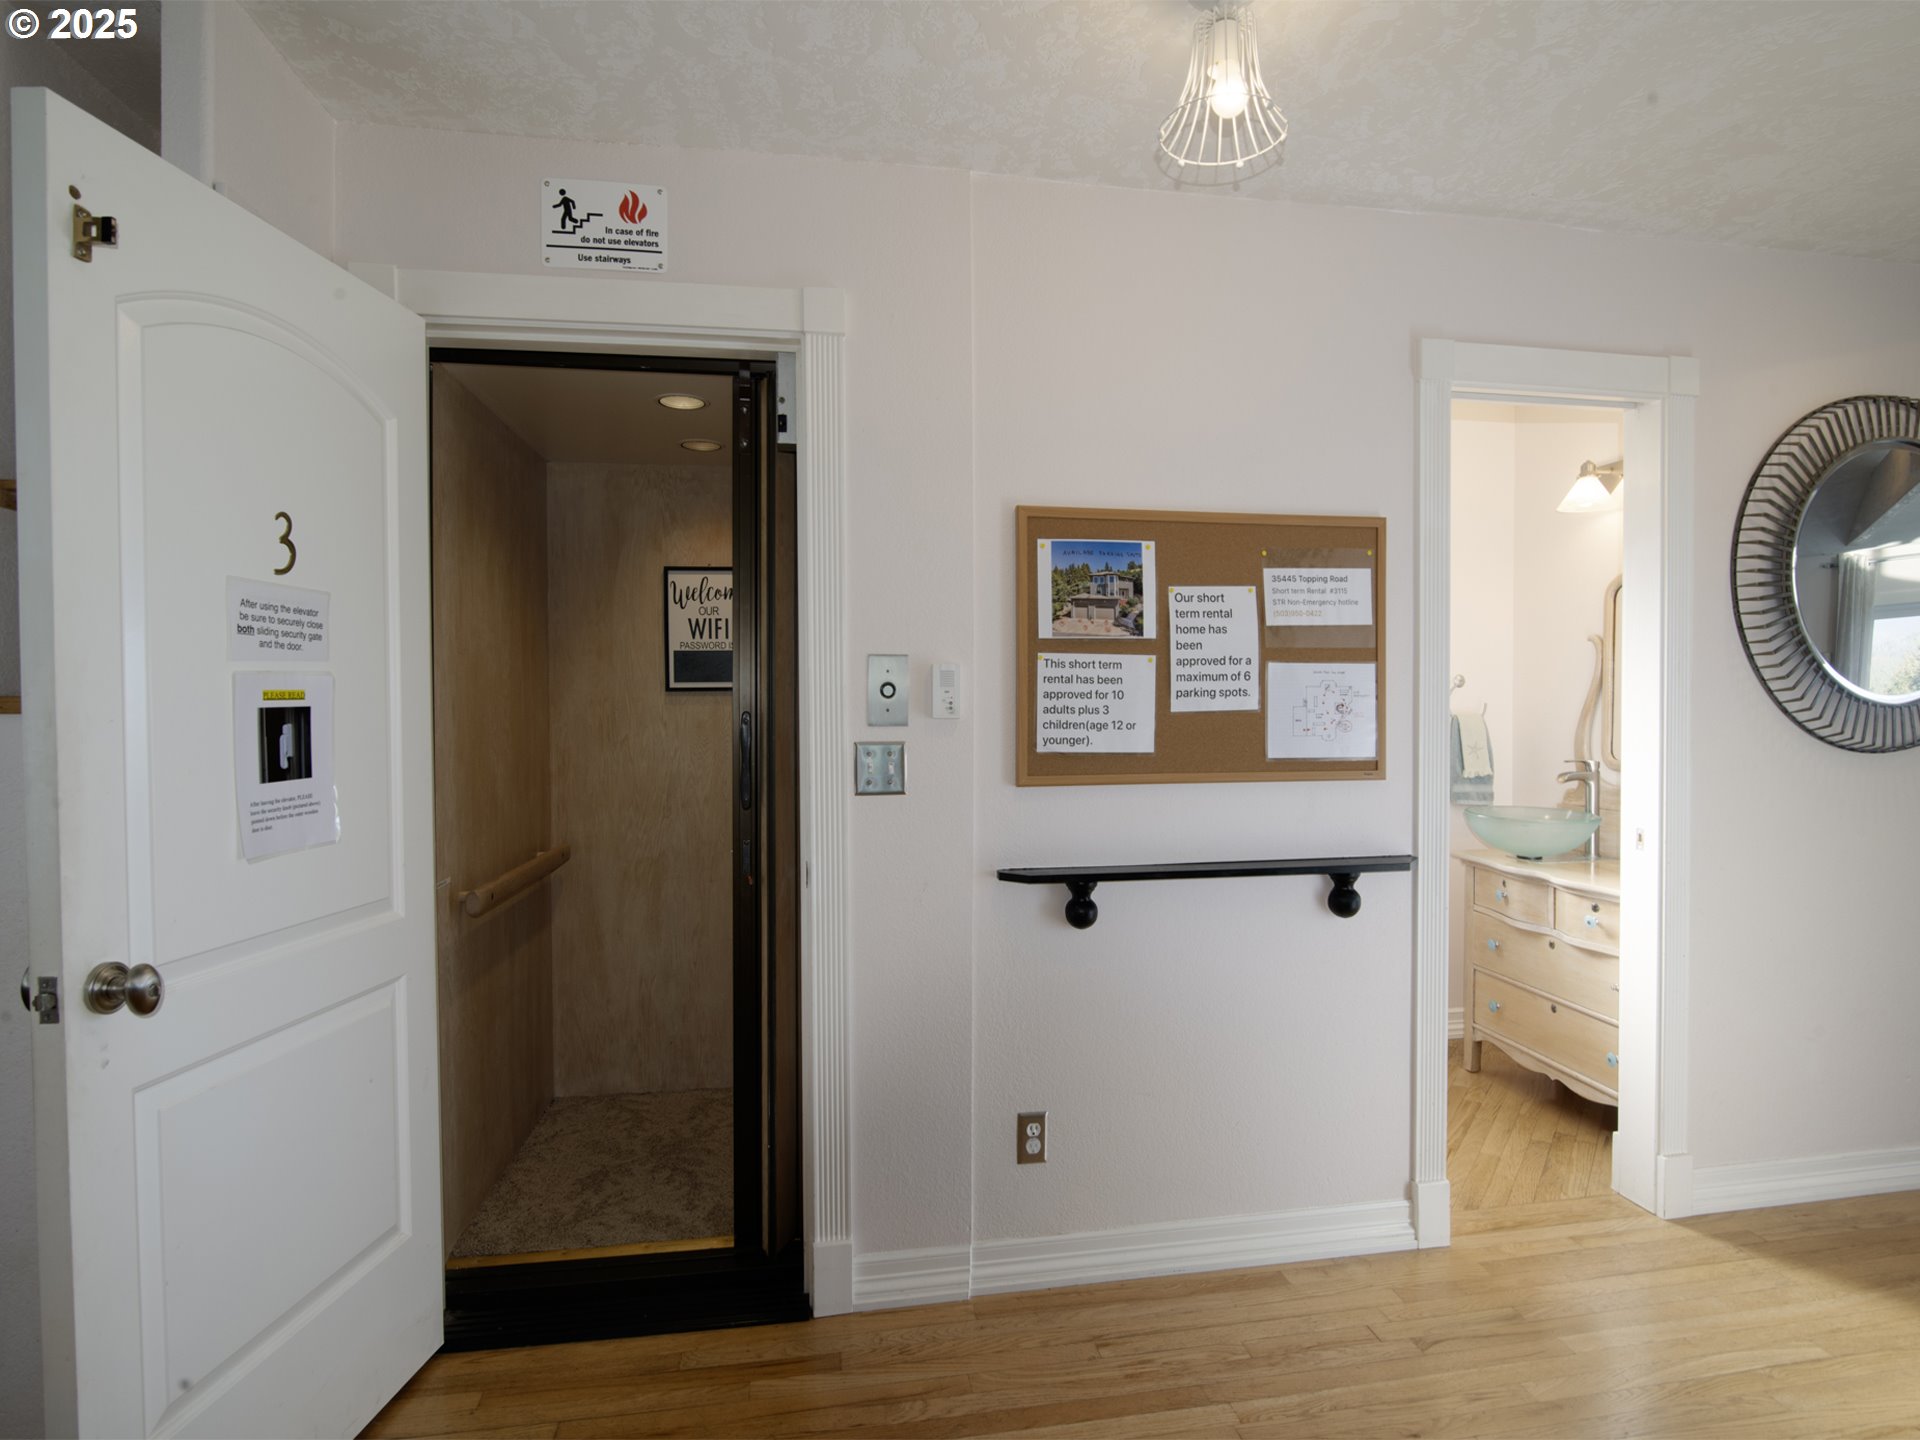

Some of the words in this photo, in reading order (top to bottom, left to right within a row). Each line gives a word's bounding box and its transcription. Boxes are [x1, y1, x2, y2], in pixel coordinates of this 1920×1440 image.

[605, 226, 613, 234] In
[636, 228, 644, 236] of
[645, 229, 659, 237] fire
[581, 235, 590, 243] do
[624, 238, 659, 248] elevators
[578, 254, 593, 262] Use
[595, 255, 631, 264] stairways
[273, 511, 296, 576] 3
[1271, 575, 1297, 583] 35445
[1299, 575, 1328, 584] Topping
[1330, 575, 1348, 583] Road
[670, 576, 733, 610] Welcom
[1174, 592, 1194, 603] Our
[1197, 593, 1225, 603] short
[240, 598, 258, 609] After
[259, 603, 279, 614] using
[280, 605, 291, 614] the
[293, 607, 319, 617] elevator
[1287, 599, 1337, 607] Non-Emergency
[698, 606, 719, 616] OUR
[1175, 609, 1200, 619] term
[1202, 609, 1233, 619] rental
[239, 612, 249, 621] be
[251, 614, 267, 623] sure
[268, 616, 275, 624] to
[277, 617, 305, 629] securely
[306, 621, 323, 630] close
[237, 624, 255, 635] both
[256, 627, 279, 639] sliding
[281, 630, 306, 641] security
[308, 633, 323, 642] gate
[688, 618, 729, 640] WIFI
[1175, 624, 1206, 634] home
[1208, 624, 1228, 634] has
[259, 640, 272, 648] and
[274, 640, 285, 649] the
[680, 641, 727, 650] PASSWORD
[1176, 640, 1203, 650] been
[1043, 658, 1066, 669] This
[1068, 659, 1096, 669] short
[1098, 660, 1122, 670] term
[1176, 656, 1226, 668] approved
[1228, 656, 1242, 666] for
[1245, 657, 1252, 666] a
[1043, 675, 1073, 684] rental
[1075, 675, 1094, 684] has
[1097, 675, 1123, 685] been
[1176, 672, 1228, 682] maximum
[1230, 671, 1241, 681] of
[1244, 671, 1251, 681] 6
[1043, 690, 1093, 701] approved
[1095, 690, 1109, 700] for
[1112, 690, 1125, 700] 10
[1176, 688, 1216, 700] parking
[1218, 688, 1251, 699] spots.
[1043, 705, 1075, 715] adults
[1078, 705, 1100, 716] plus
[1102, 705, 1110, 715] 3
[1043, 720, 1109, 732] children(age
[1111, 721, 1123, 730] 12
[1126, 722, 1137, 730] or
[1043, 736, 1093, 747] younger).
